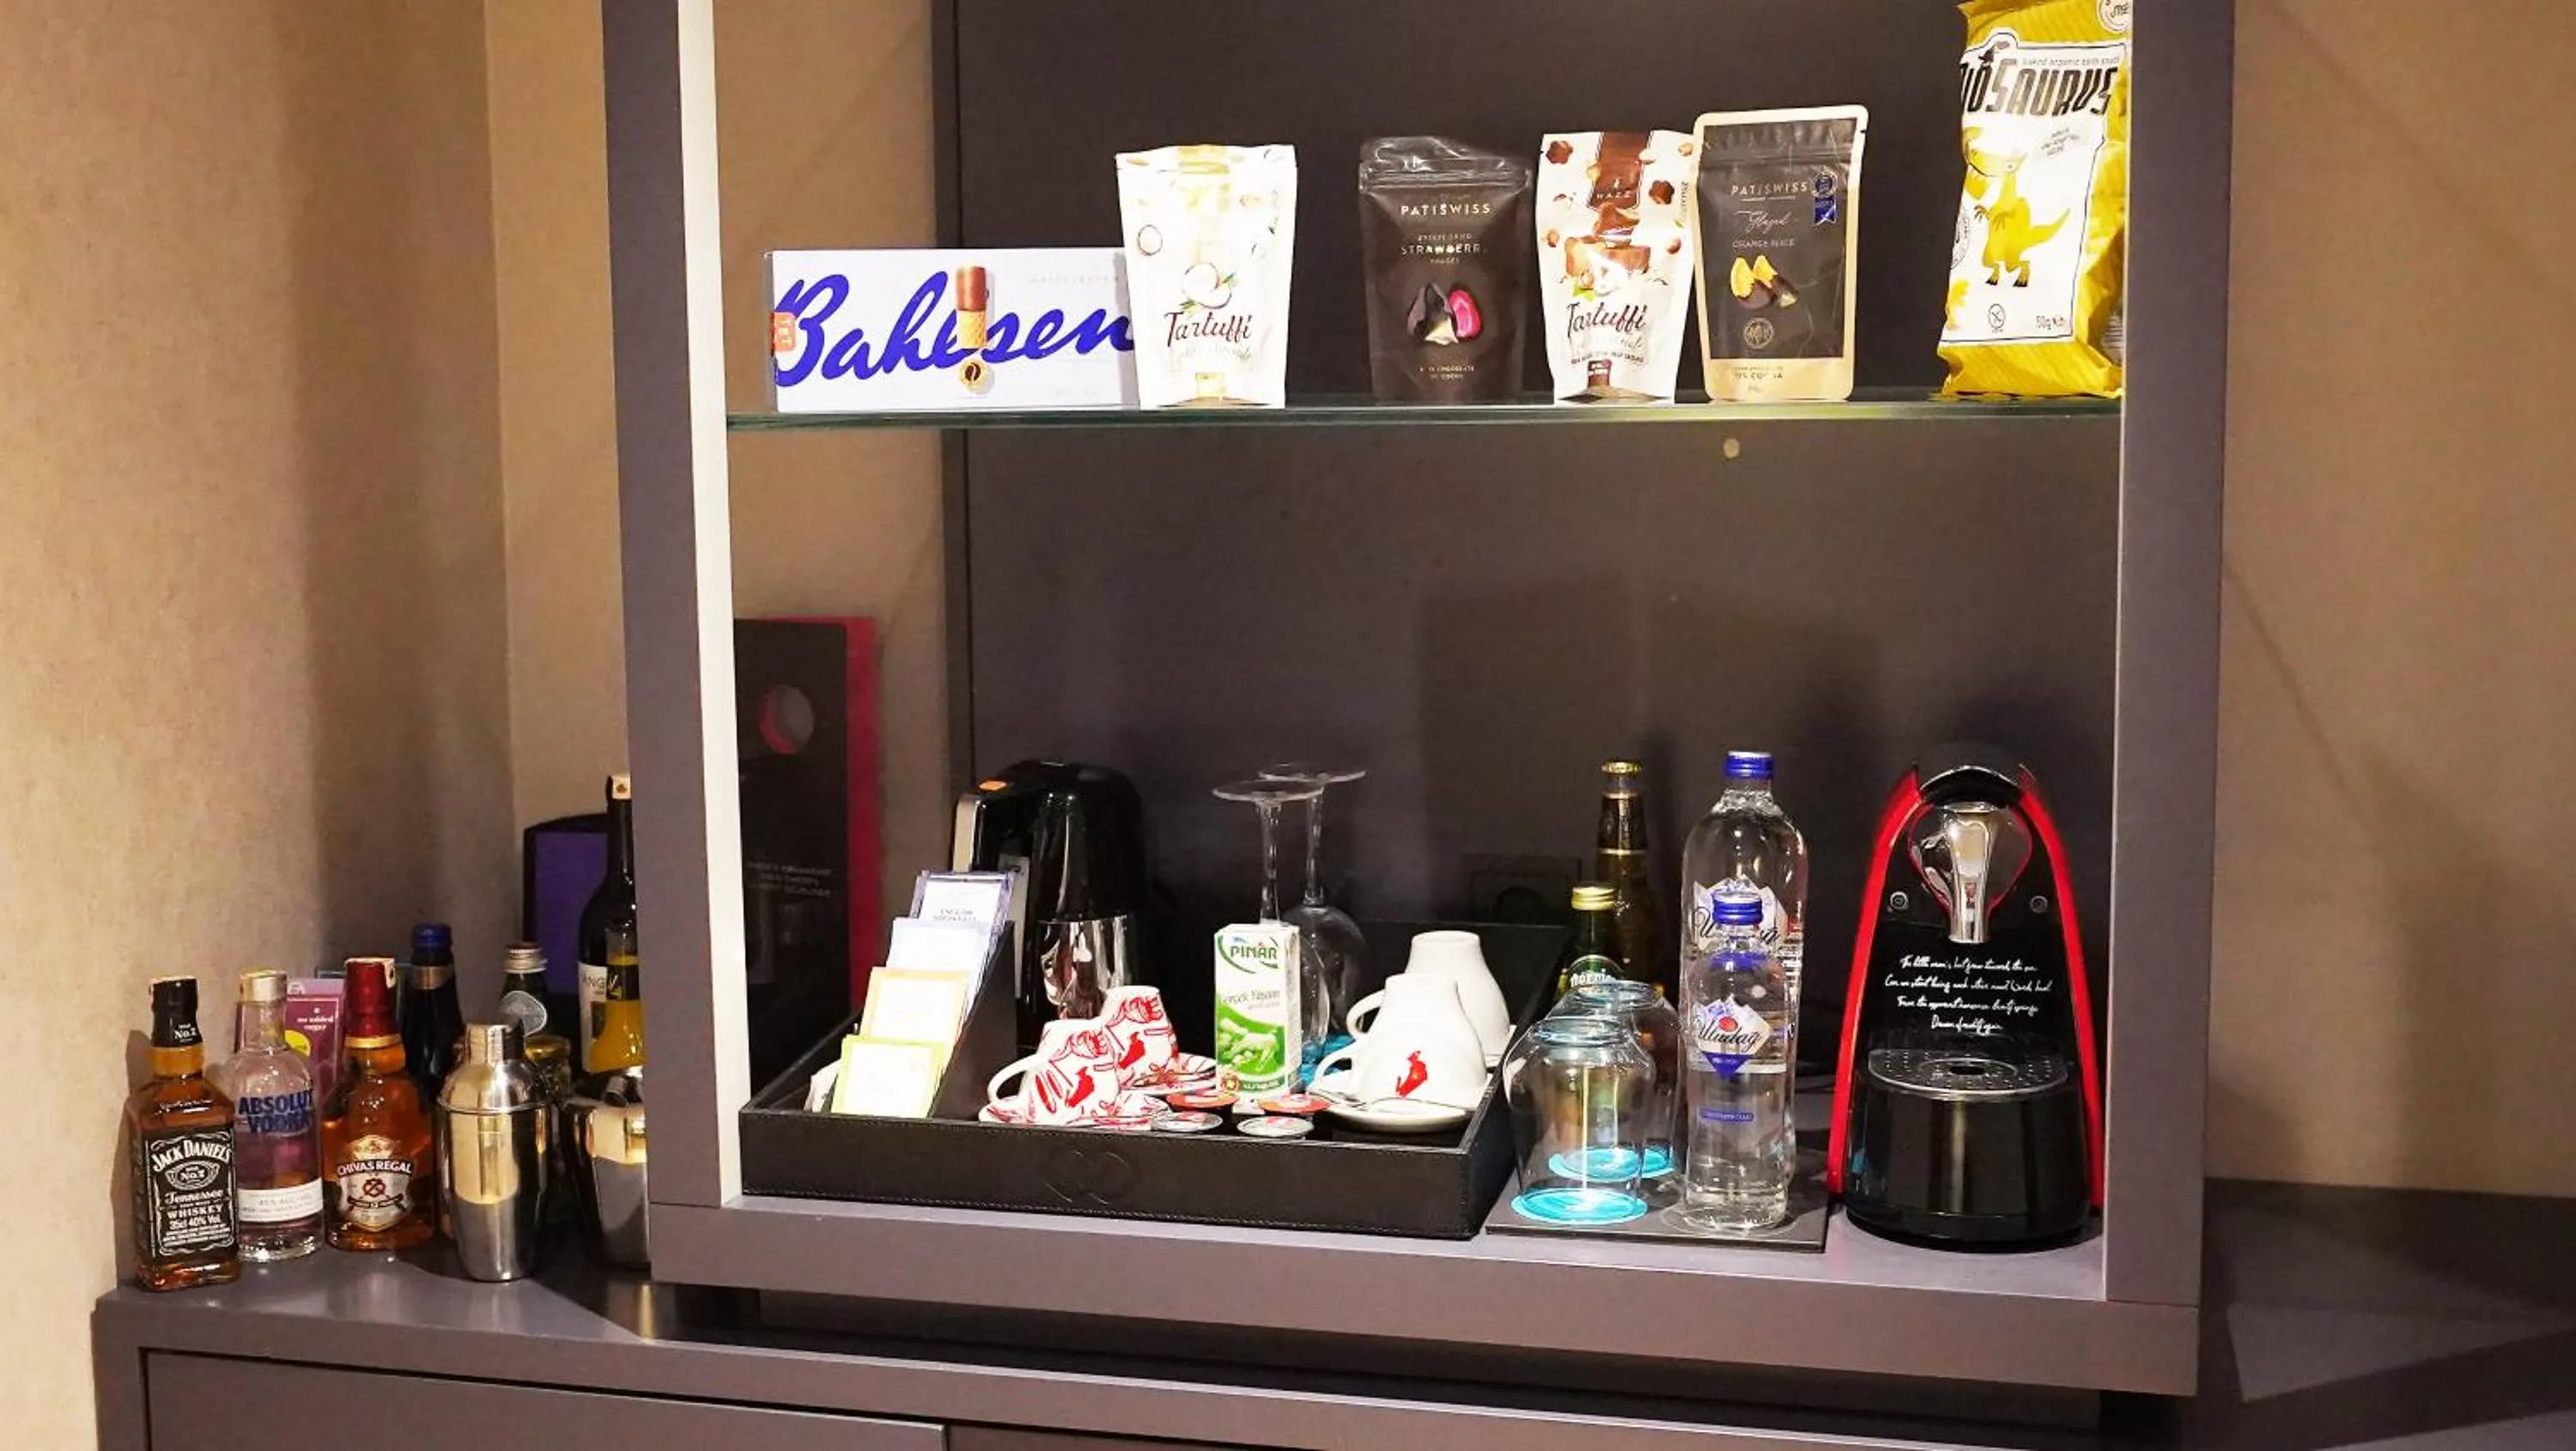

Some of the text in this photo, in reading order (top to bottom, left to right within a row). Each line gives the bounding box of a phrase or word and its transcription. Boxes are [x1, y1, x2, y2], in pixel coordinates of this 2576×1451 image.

[1730, 181, 1809, 196] PATISWISS
[1400, 203, 1491, 216] PATISWISS
[1164, 311, 1252, 348] Tartuffi
[1230, 945, 1278, 959] PINAR
[238, 1088, 313, 1114] ABSOLUT
[151, 1144, 185, 1172] JACK
[337, 1160, 412, 1175] CHIVAS REGAL
[167, 1204, 223, 1219] WHISKEY
